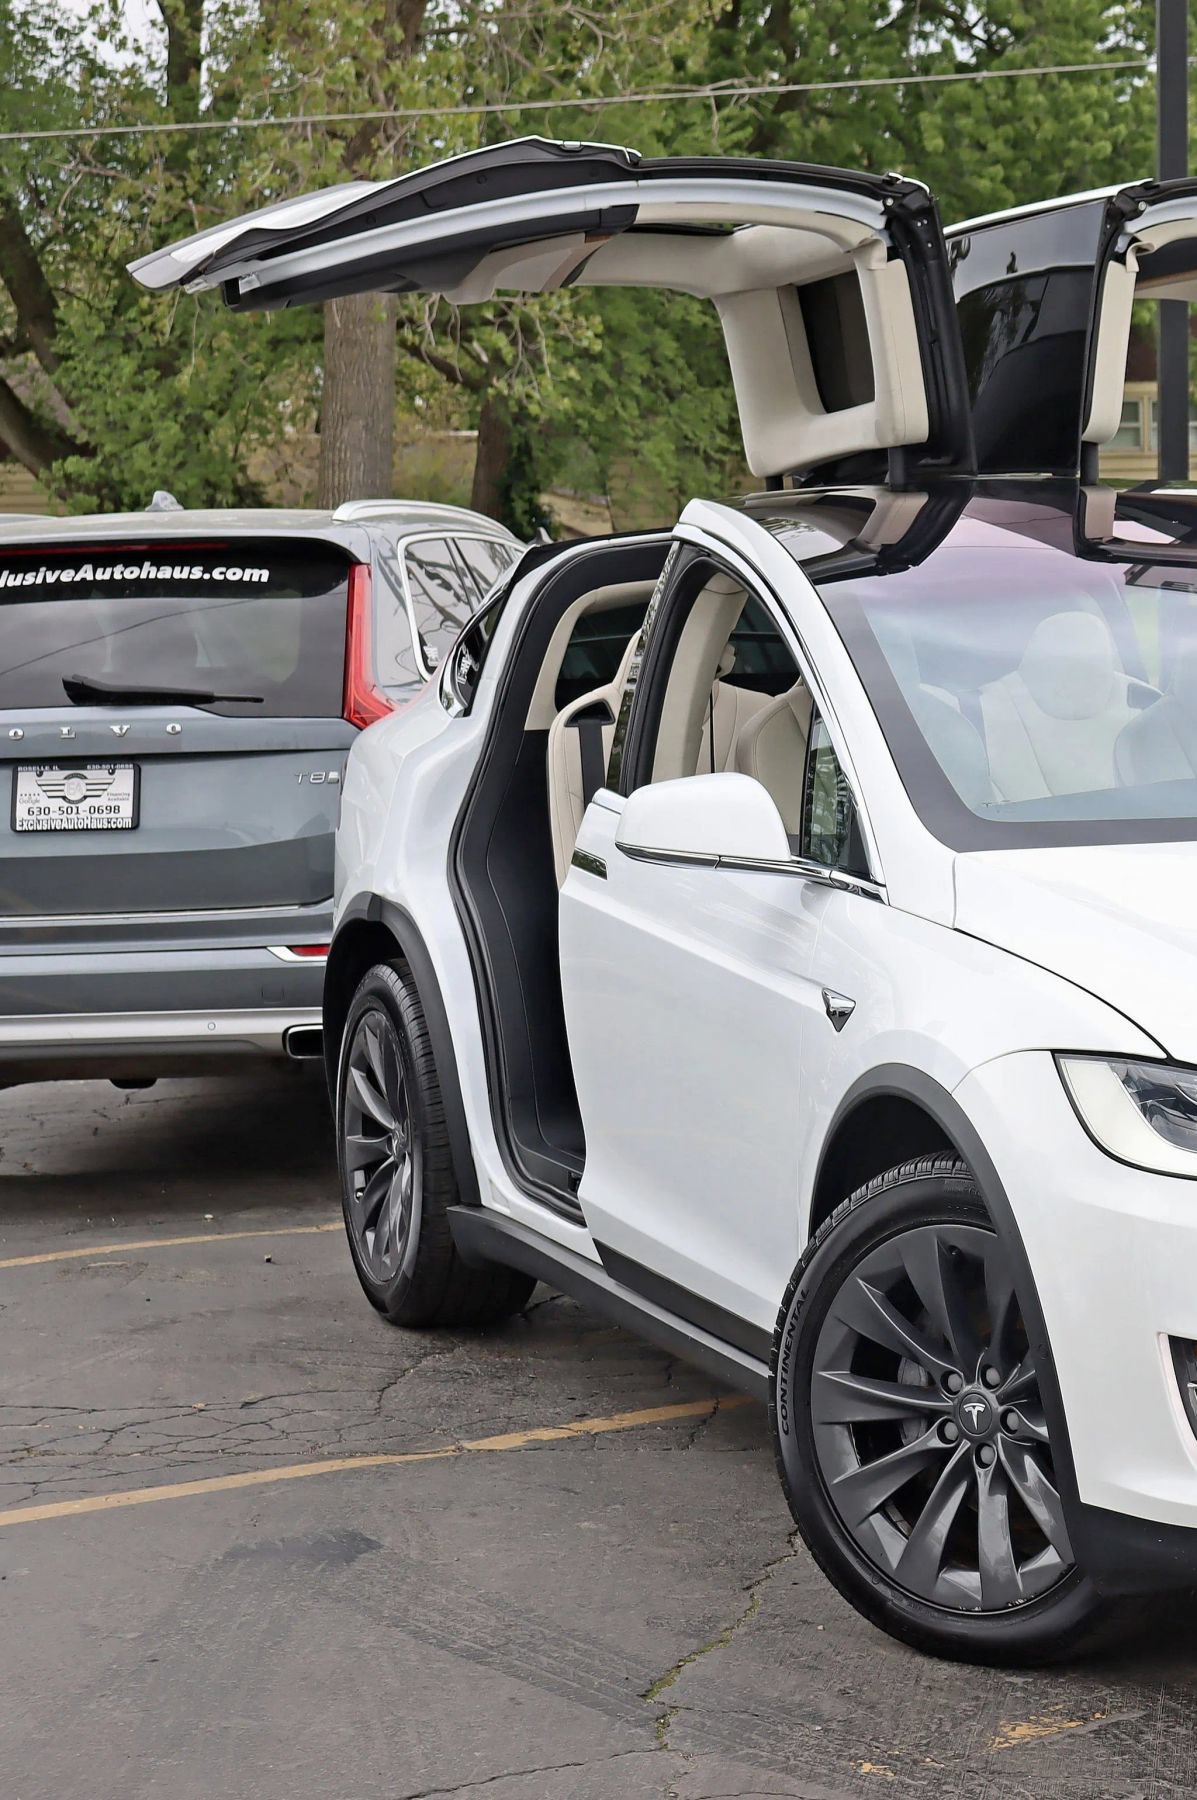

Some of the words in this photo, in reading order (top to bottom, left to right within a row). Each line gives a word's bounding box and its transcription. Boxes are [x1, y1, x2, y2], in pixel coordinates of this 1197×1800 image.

[8, 723, 182, 739] OLVO
[27, 804, 121, 816] 630-501-0698
[16, 816, 132, 831] ExclusiveAutoHaus.com
[780, 1288, 810, 1436] CONTINENTAL
